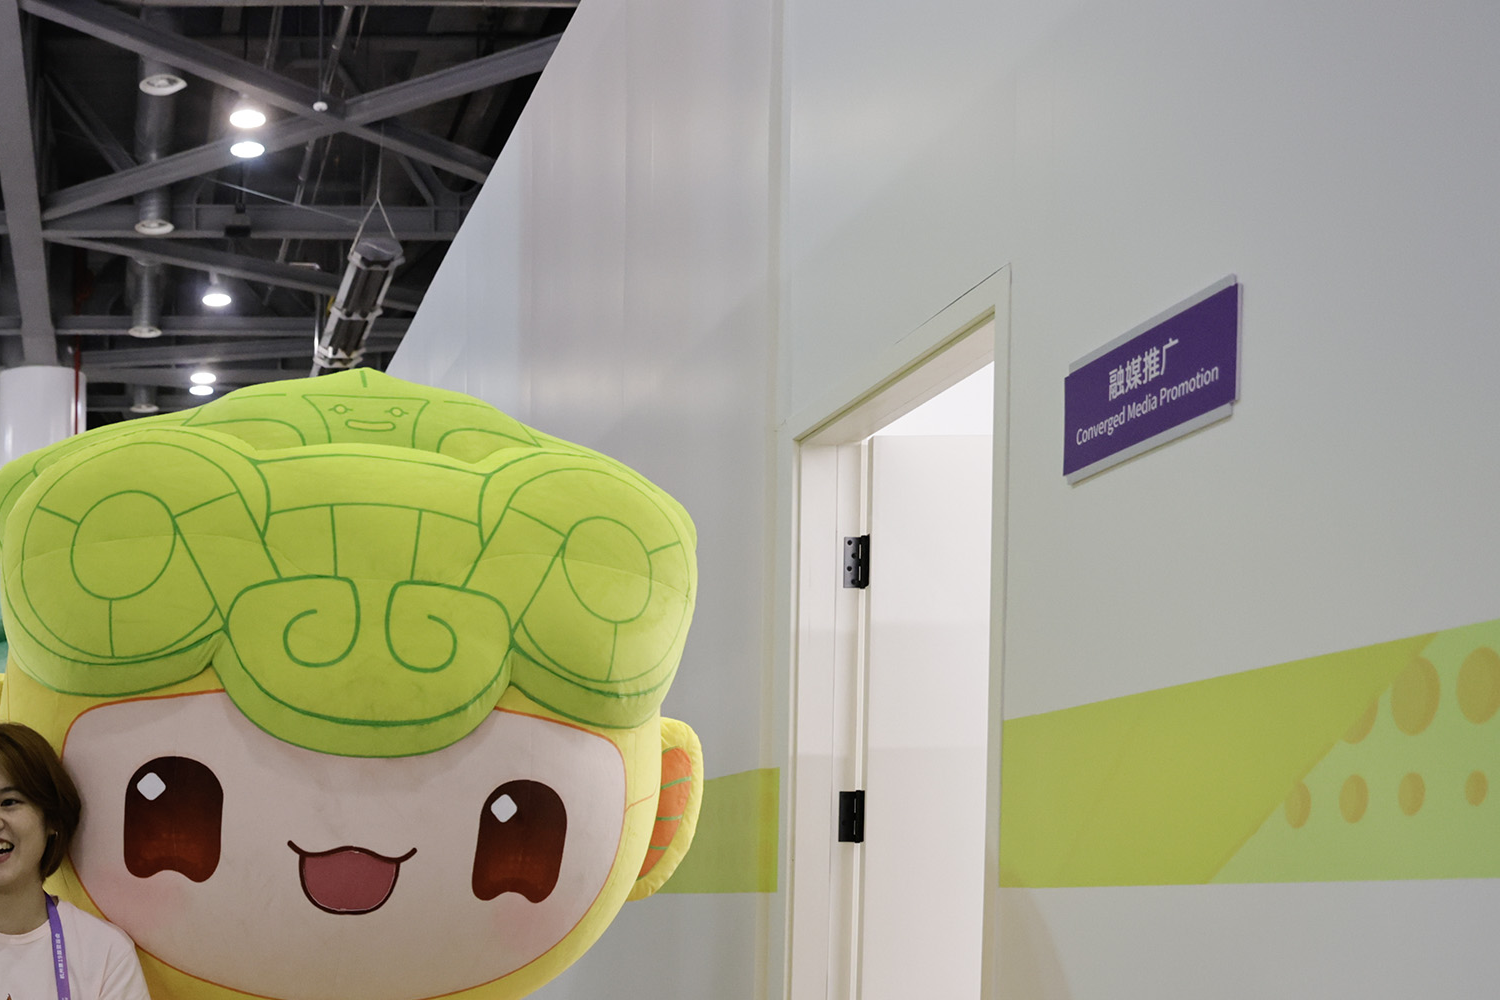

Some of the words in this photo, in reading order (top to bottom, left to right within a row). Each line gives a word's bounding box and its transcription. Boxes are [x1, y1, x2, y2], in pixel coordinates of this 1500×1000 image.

[1108, 337, 1179, 401] 融媒推广
[1076, 405, 1126, 445] Converged
[1127, 393, 1158, 421] Media
[1160, 366, 1219, 406] Promotion
